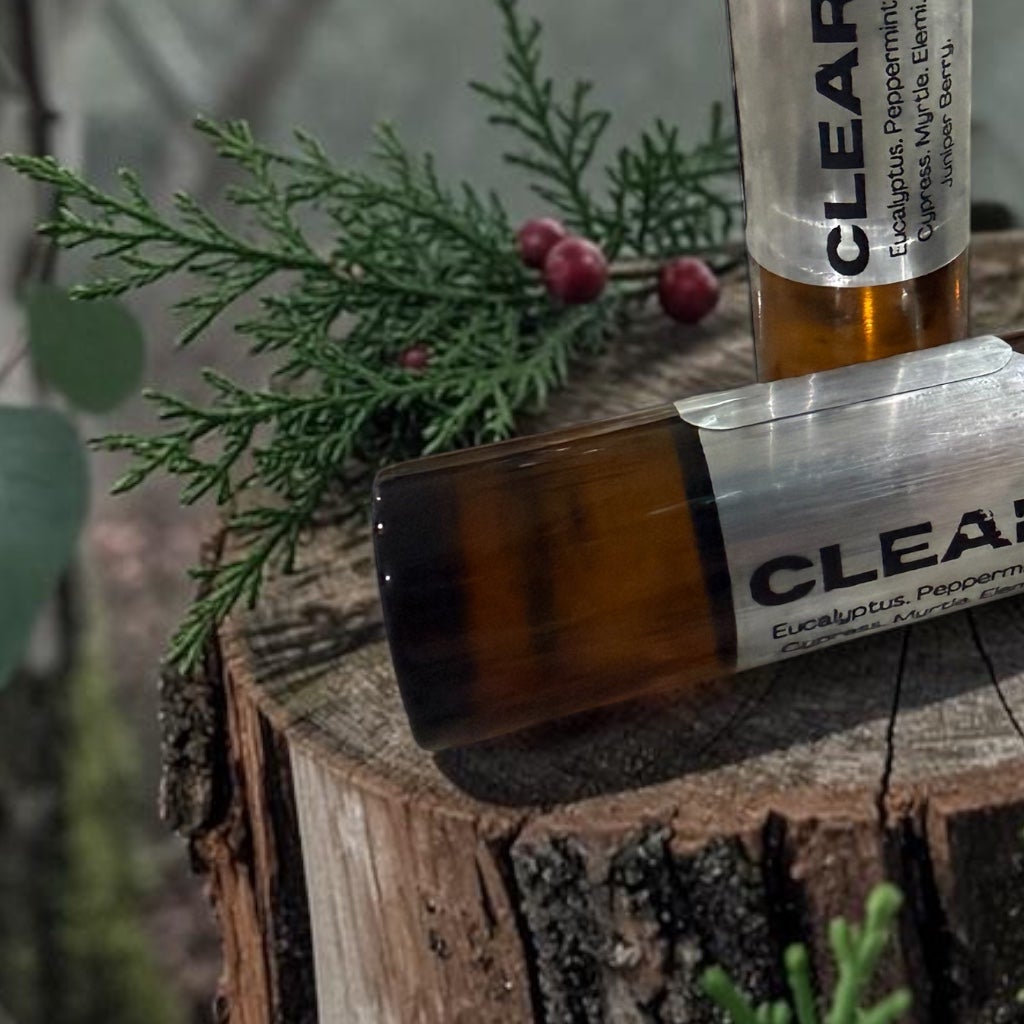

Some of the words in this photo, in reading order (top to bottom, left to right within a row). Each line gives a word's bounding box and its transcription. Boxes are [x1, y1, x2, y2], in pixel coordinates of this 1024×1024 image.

[912, 67, 934, 148] Myrtle.
[939, 38, 955, 110] Berry.
[939, 113, 956, 188] Juniper
[886, 138, 910, 258] Eucalyptus.
[915, 150, 936, 242] Cypress.
[772, 595, 911, 640] Eucalyptus.
